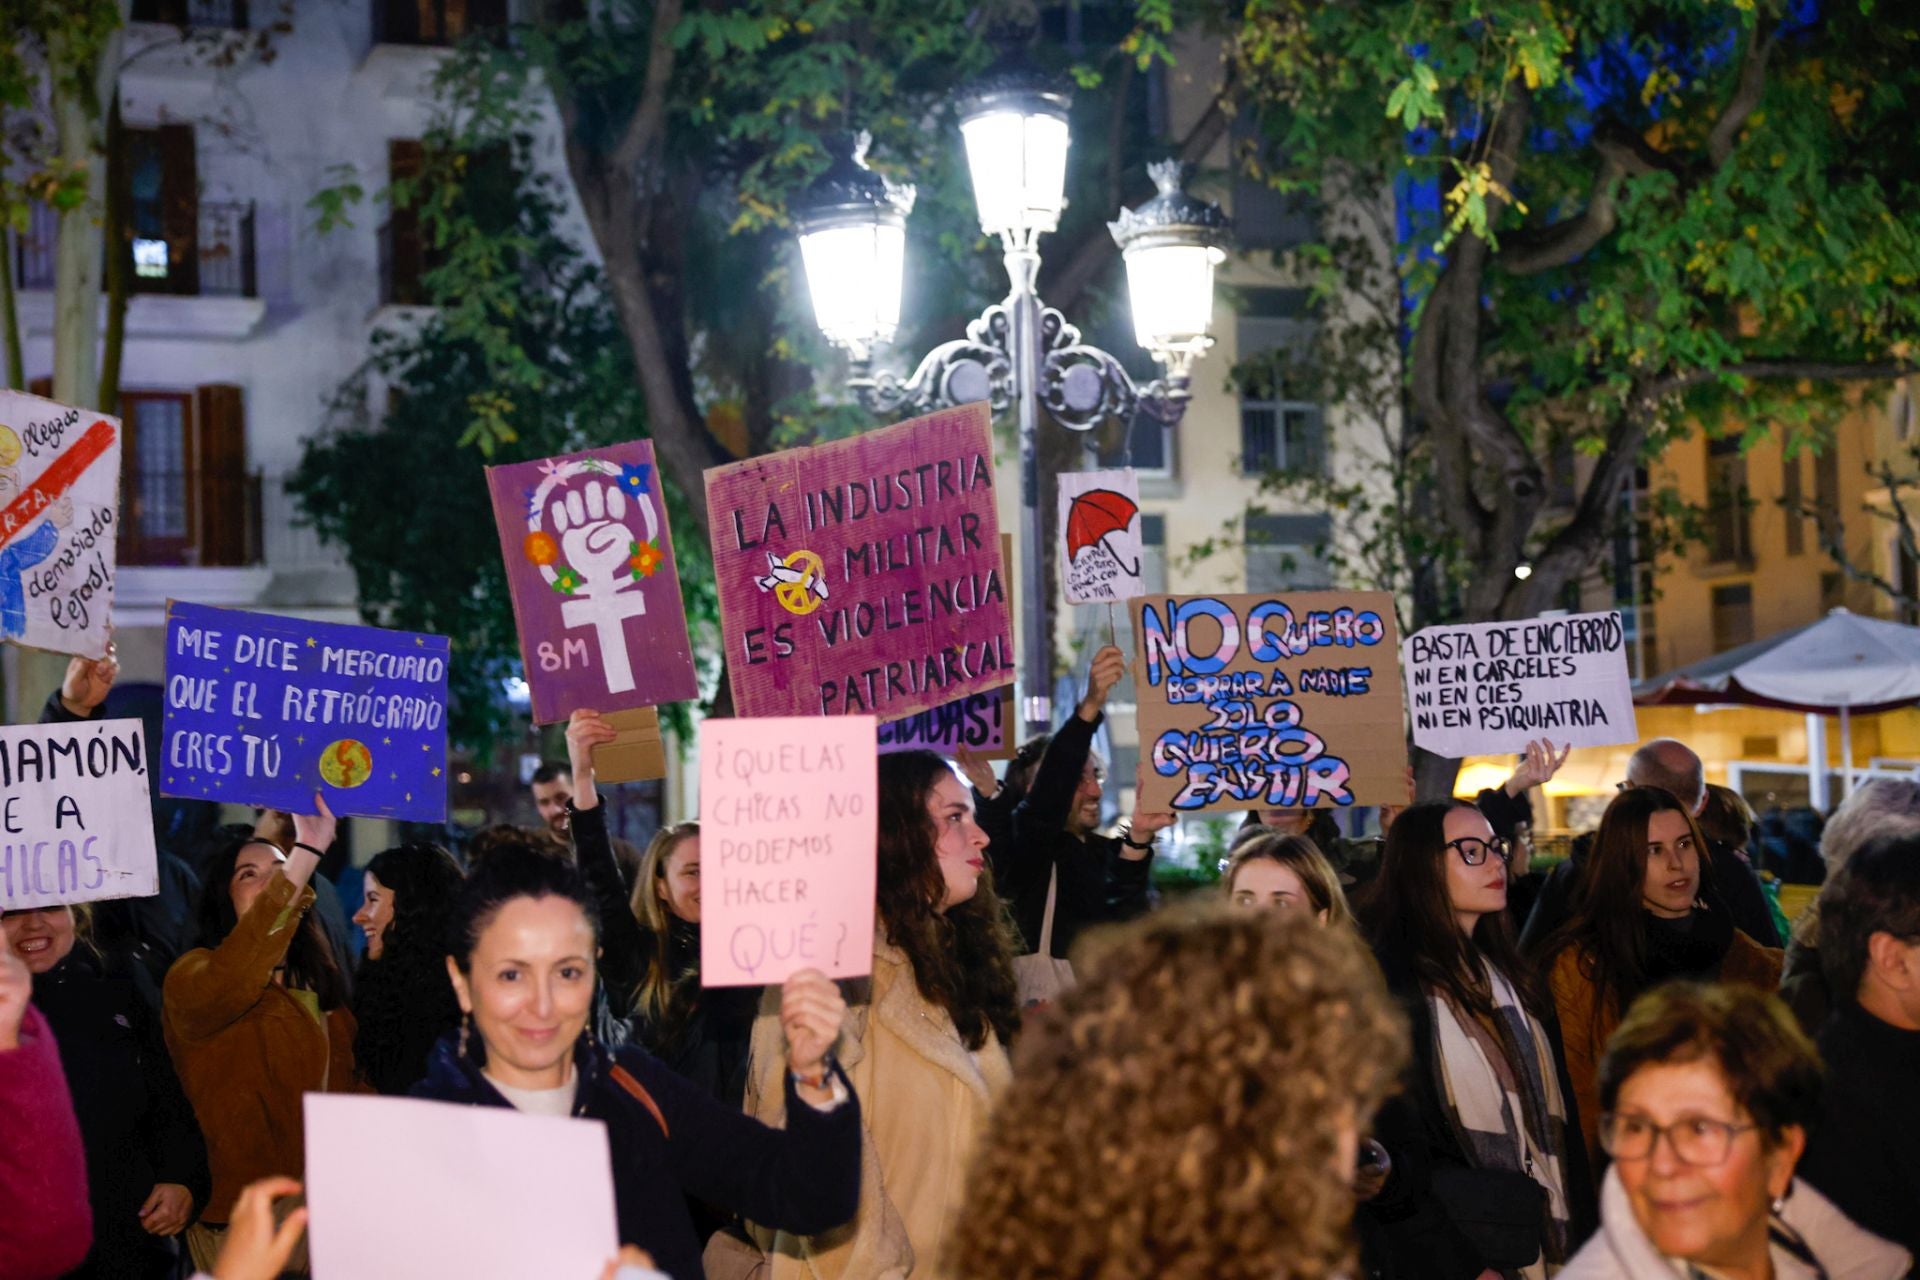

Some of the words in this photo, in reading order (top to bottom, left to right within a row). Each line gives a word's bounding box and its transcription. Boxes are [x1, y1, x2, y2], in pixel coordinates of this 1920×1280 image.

[733, 502, 787, 551] LA
[806, 454, 991, 531] INDUSTRIA
[29, 507, 112, 598] demasiado
[844, 513, 982, 583] MILITAR
[1100, 568, 1118, 581] CON
[744, 623, 795, 665] ES
[817, 569, 1004, 648] VIOLENCIA
[1412, 632, 1479, 664] BASTA
[1486, 627, 1520, 658] DE
[1524, 612, 1622, 655] ENCIERROS
[177, 626, 222, 660] ME
[234, 635, 299, 671] DICE
[322, 646, 443, 683] MERCURIO
[537, 638, 589, 672] 8M
[1142, 598, 1241, 686] NO
[819, 634, 1015, 717] PATRIARCAL
[1167, 671, 1265, 704] BORRAR
[1266, 668, 1294, 696] A
[1300, 667, 1372, 698] NADIE
[1414, 668, 1431, 686] NI
[1438, 664, 1468, 684] EN
[1473, 656, 1577, 683] CARCELES
[169, 674, 219, 713] QUE
[231, 681, 262, 719] EL
[282, 686, 442, 730] RETRÓGRADO
[1200, 700, 1303, 731] SOLO
[1416, 691, 1432, 707] NI
[1439, 685, 1468, 706] EN
[1475, 683, 1523, 705] CIES
[1417, 711, 1438, 730] NI
[1443, 707, 1472, 728] EN
[1478, 699, 1609, 731] PSIQUIATRIA
[170, 730, 232, 775] ERES
[242, 734, 281, 777] TÚ
[1152, 728, 1327, 777] QUIERO
[56, 795, 85, 830] A
[713, 793, 801, 826] CHICAS
[824, 793, 864, 820] NO
[720, 834, 833, 868] PODEMOS
[724, 877, 808, 906] HACER
